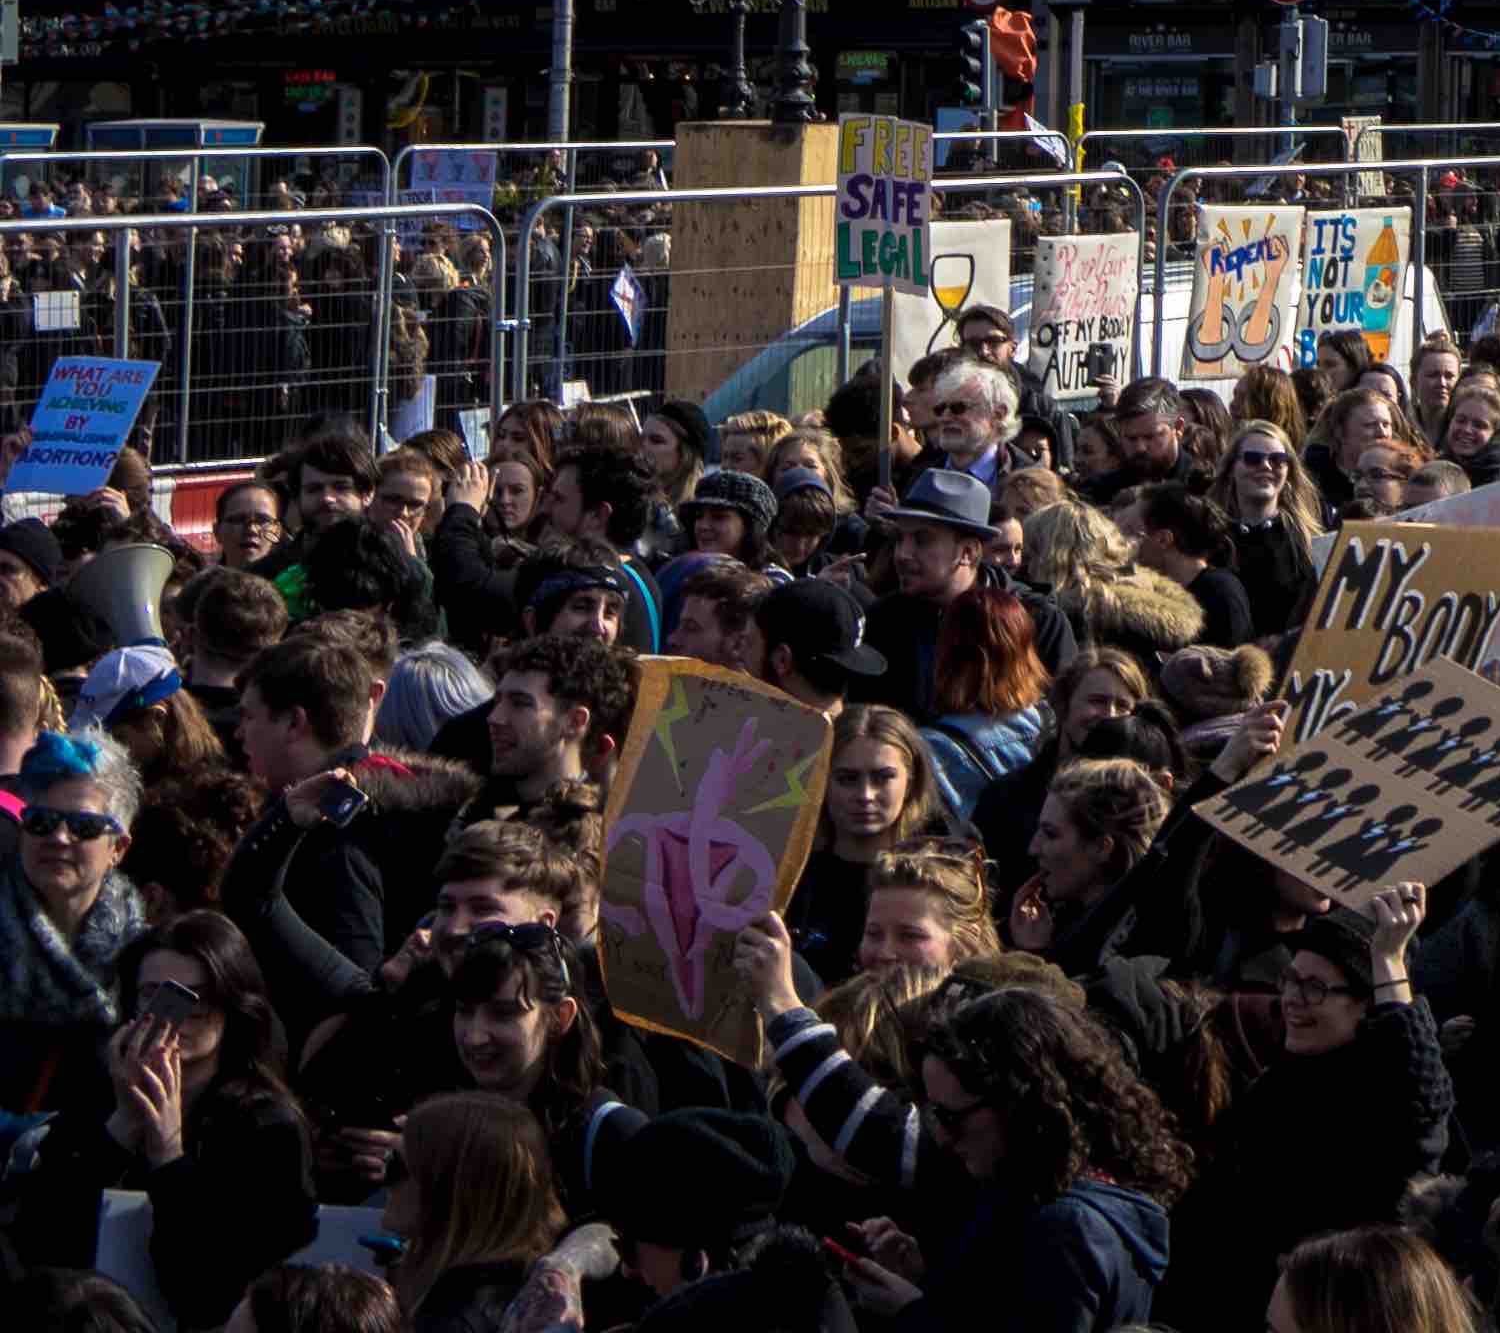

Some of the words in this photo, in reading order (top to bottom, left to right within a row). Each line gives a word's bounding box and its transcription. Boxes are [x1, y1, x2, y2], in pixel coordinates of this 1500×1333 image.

[1128, 33, 1164, 47] RIVER
[1167, 33, 1192, 47] BAR
[1348, 33, 1374, 47] BAR
[841, 117, 931, 180] FREE
[841, 174, 926, 226] SAFE
[837, 221, 929, 284] LEGAL
[1312, 214, 1356, 256] IT'S
[1210, 235, 1279, 281] REPEAL
[1308, 255, 1354, 290] NOT
[1306, 292, 1364, 327] YOUR
[1038, 320, 1072, 347] OFF
[1076, 316, 1095, 341] MY
[54, 366, 106, 382] WHAT
[109, 369, 145, 384] ARE
[1042, 347, 1127, 390] AUTOMY
[46, 395, 128, 413] ACHIEVING
[73, 382, 113, 398] YOU
[63, 414, 91, 430] BY
[18, 447, 118, 469] ABORTION?
[1318, 536, 1432, 631] MY
[1283, 668, 1353, 741] MY
